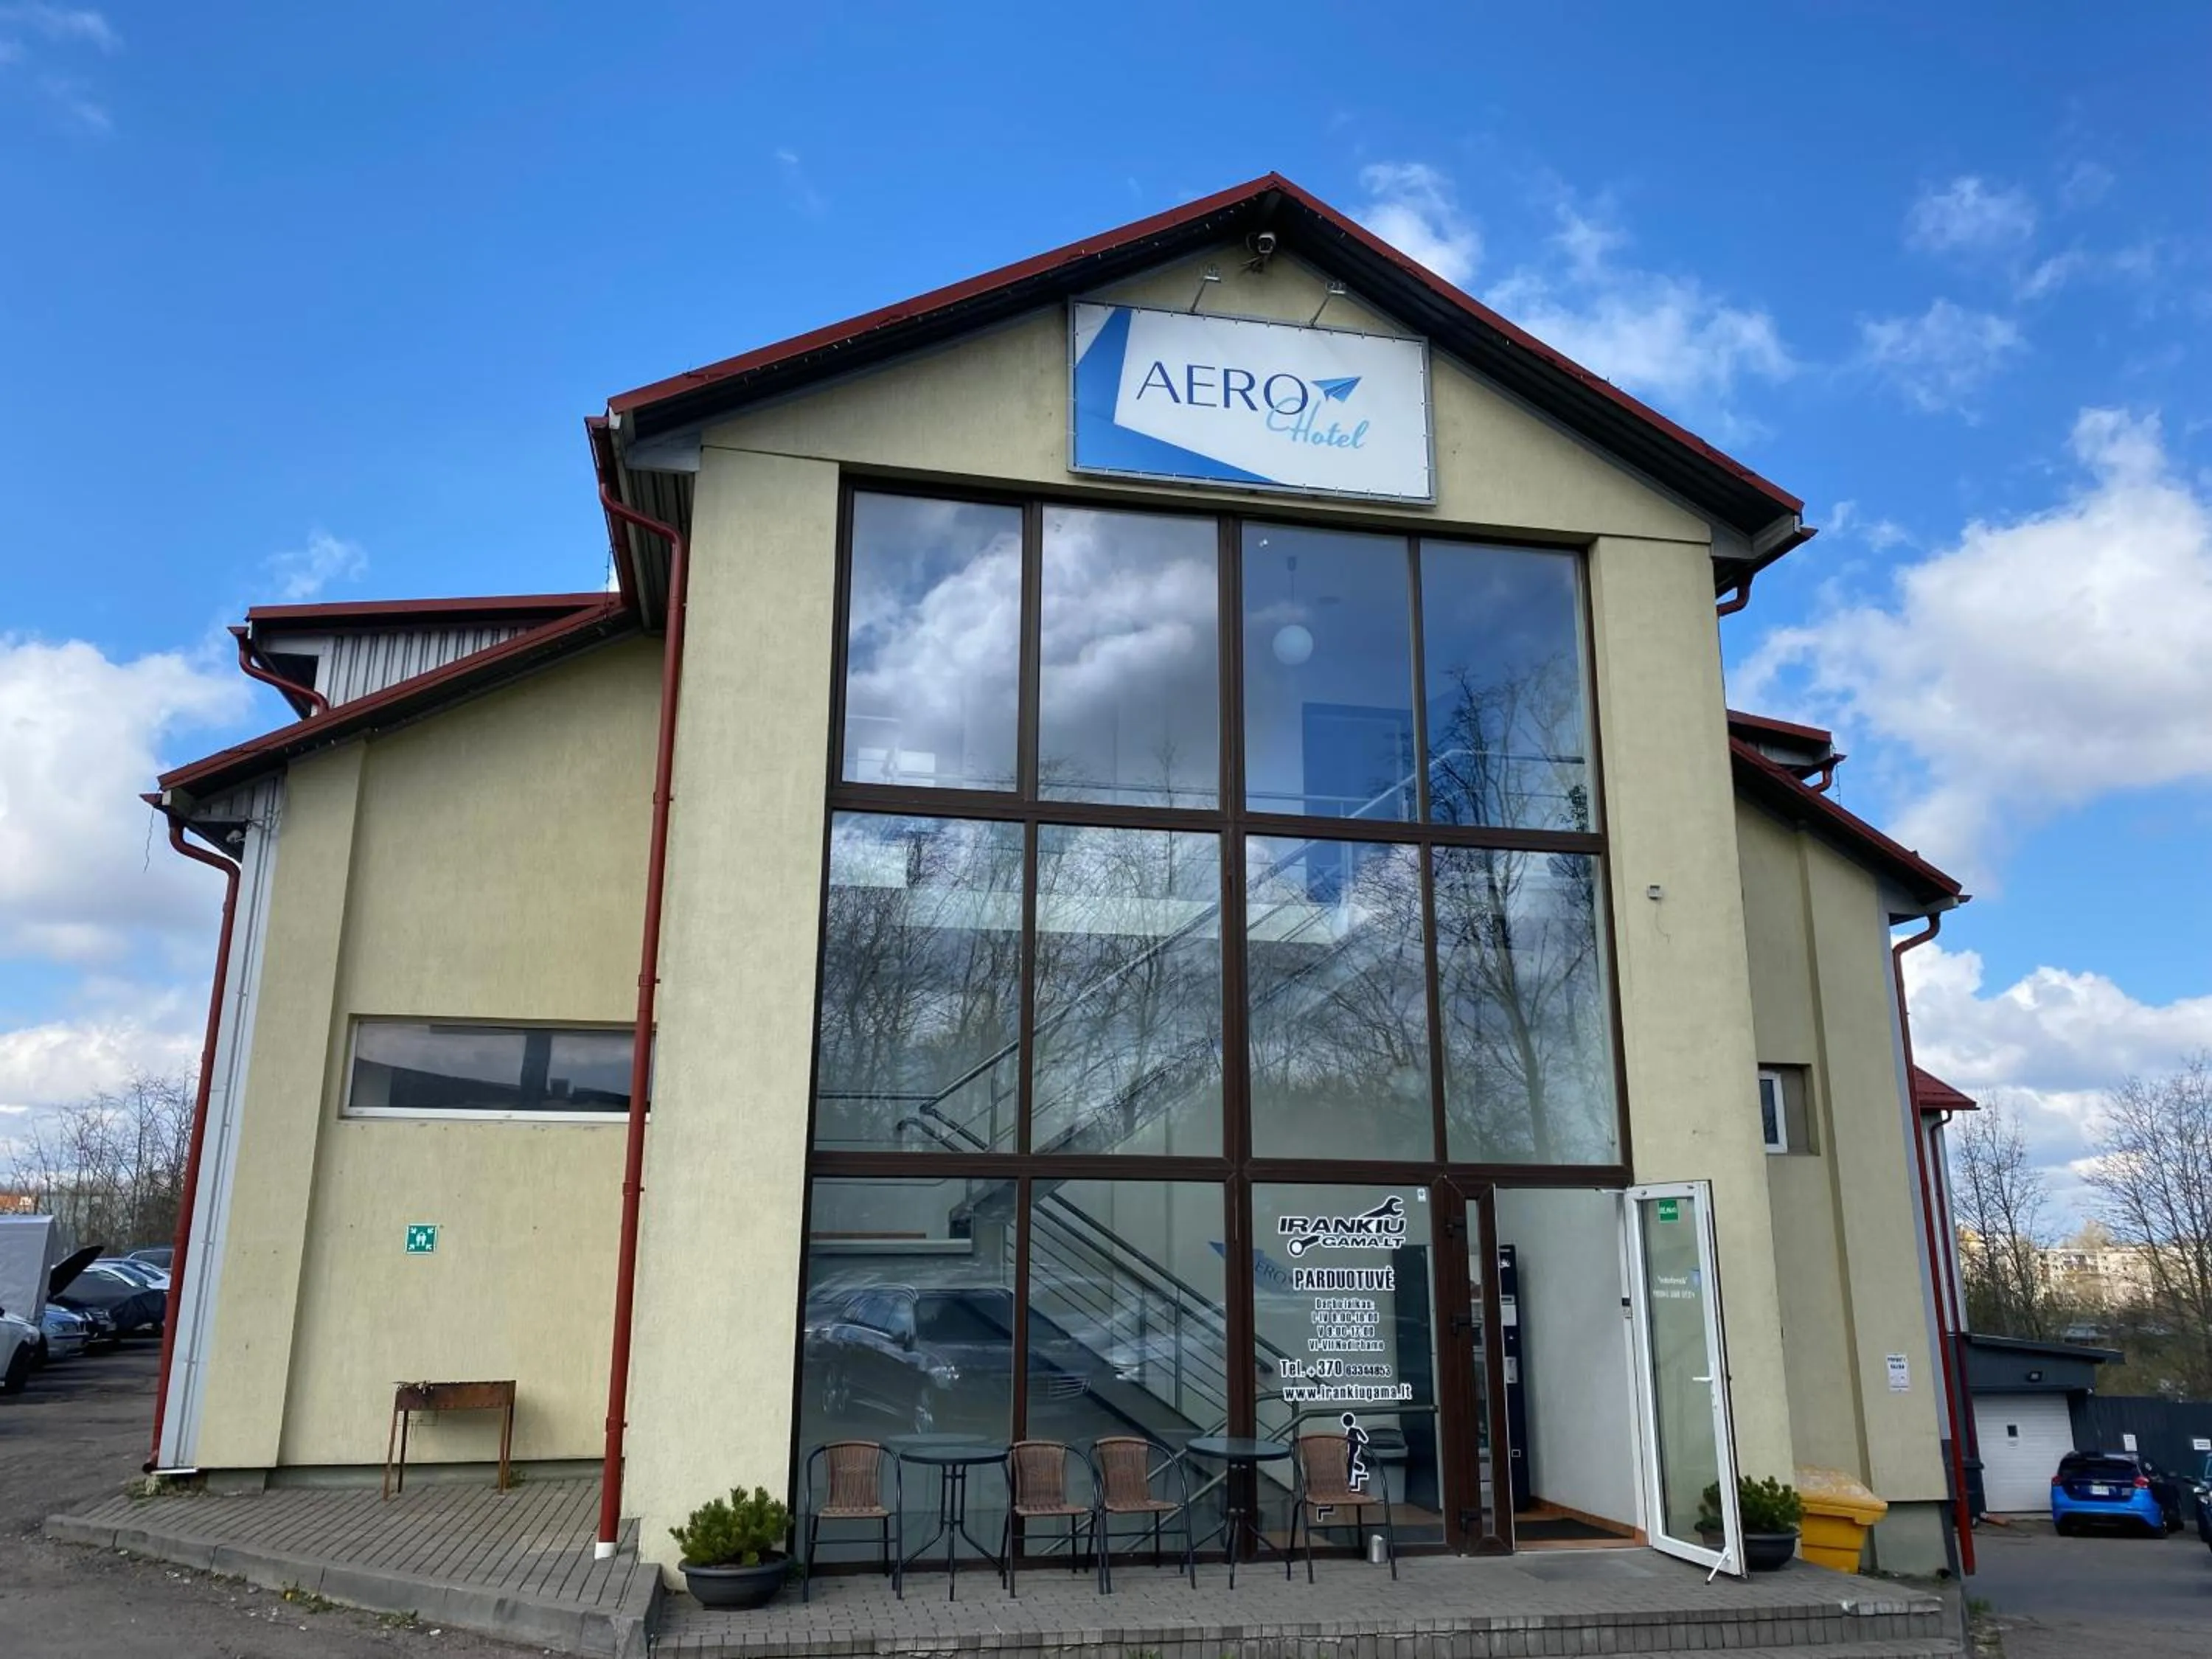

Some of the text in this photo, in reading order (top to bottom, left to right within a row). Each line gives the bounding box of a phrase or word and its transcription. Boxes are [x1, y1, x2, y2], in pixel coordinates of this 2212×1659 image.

[1135, 361, 1309, 415] AERO
[1265, 397, 1370, 449] Hotel
[1279, 1217, 1406, 1234] IRANKIU
